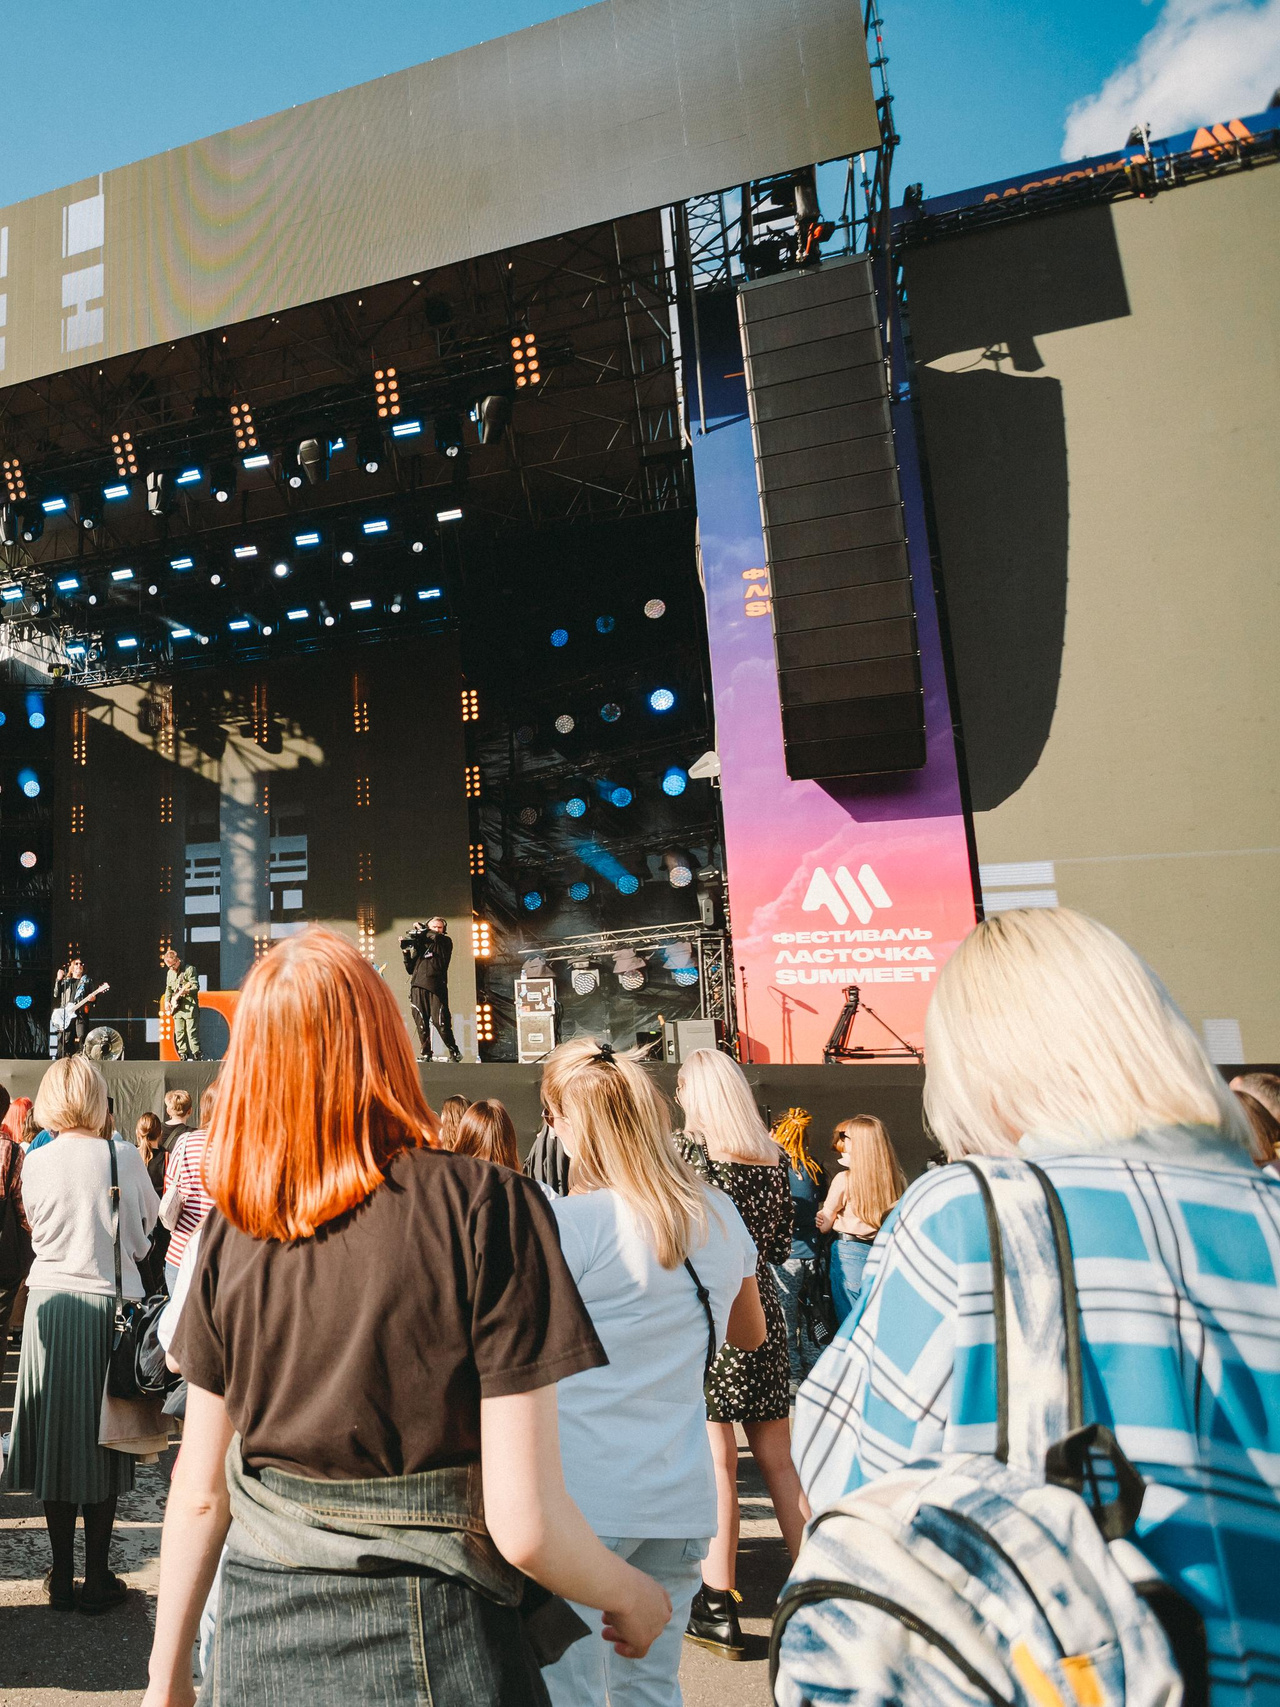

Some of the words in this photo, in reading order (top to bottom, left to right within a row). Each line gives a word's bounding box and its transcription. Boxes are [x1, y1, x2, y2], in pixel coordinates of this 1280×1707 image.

[772, 927, 933, 944] ФЕСТИВАЛЬ
[774, 946, 935, 964] ЛАСТОЧКА
[775, 966, 937, 985] SUMMEET
